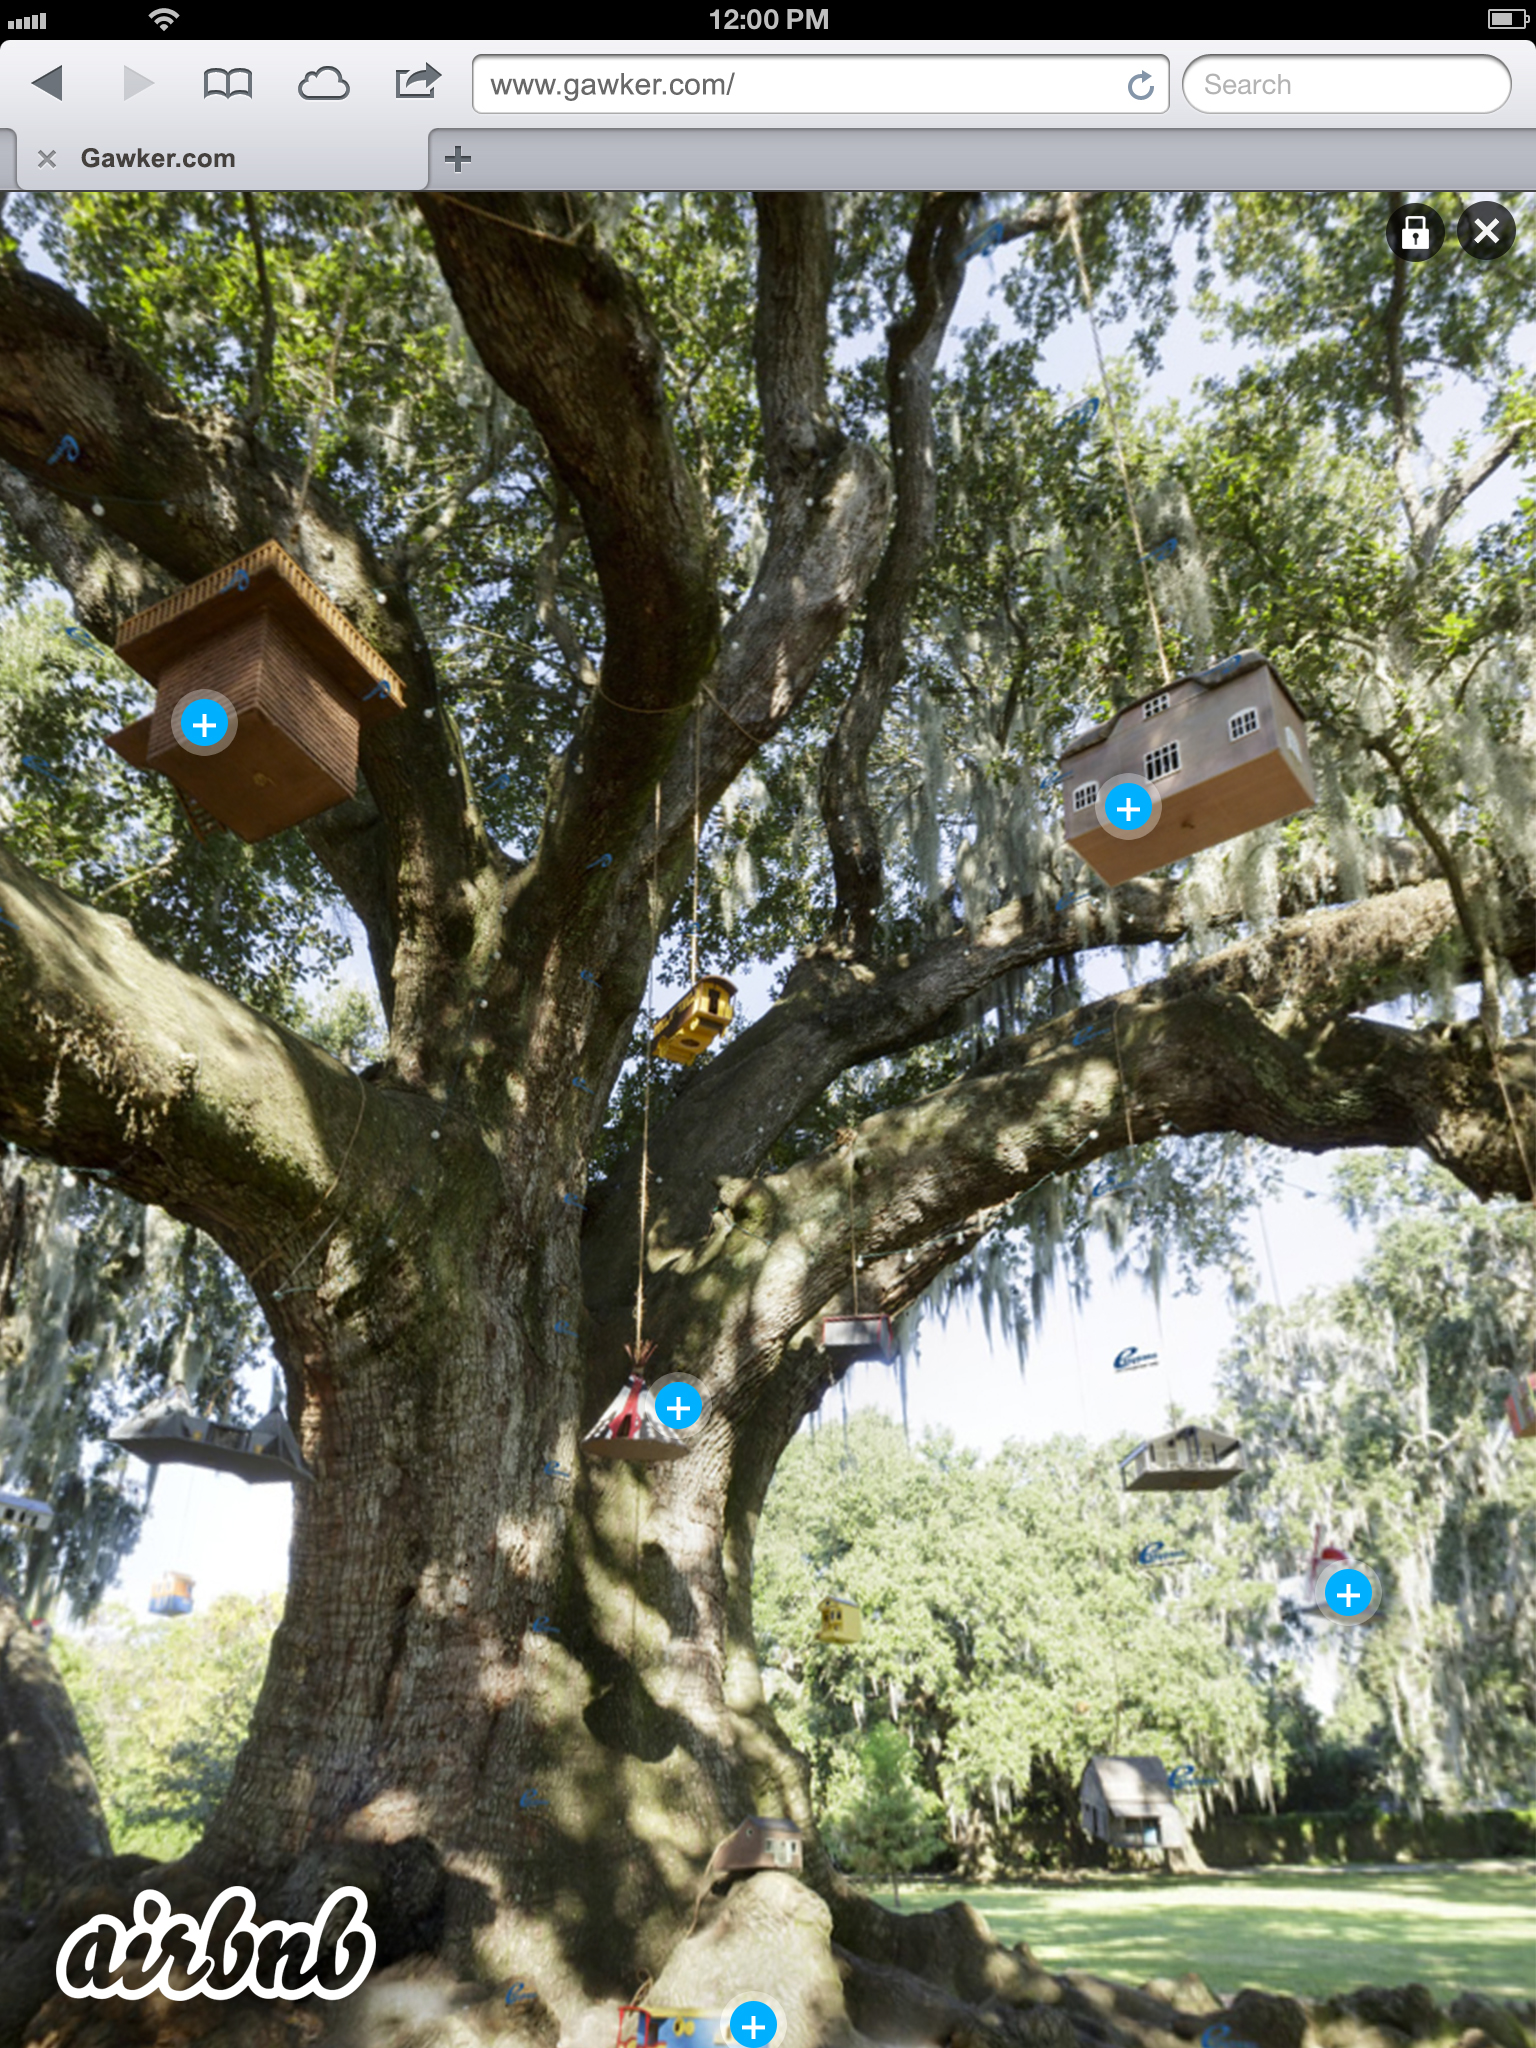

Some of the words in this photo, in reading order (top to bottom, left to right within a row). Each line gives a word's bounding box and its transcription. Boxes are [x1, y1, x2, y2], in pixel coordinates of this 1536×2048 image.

[709, 9, 780, 30] 12:00
[787, 9, 829, 30] PM
[490, 71, 736, 102] www.gawker.com/
[1204, 73, 1291, 96] Search
[81, 147, 236, 168] Gawker.com
